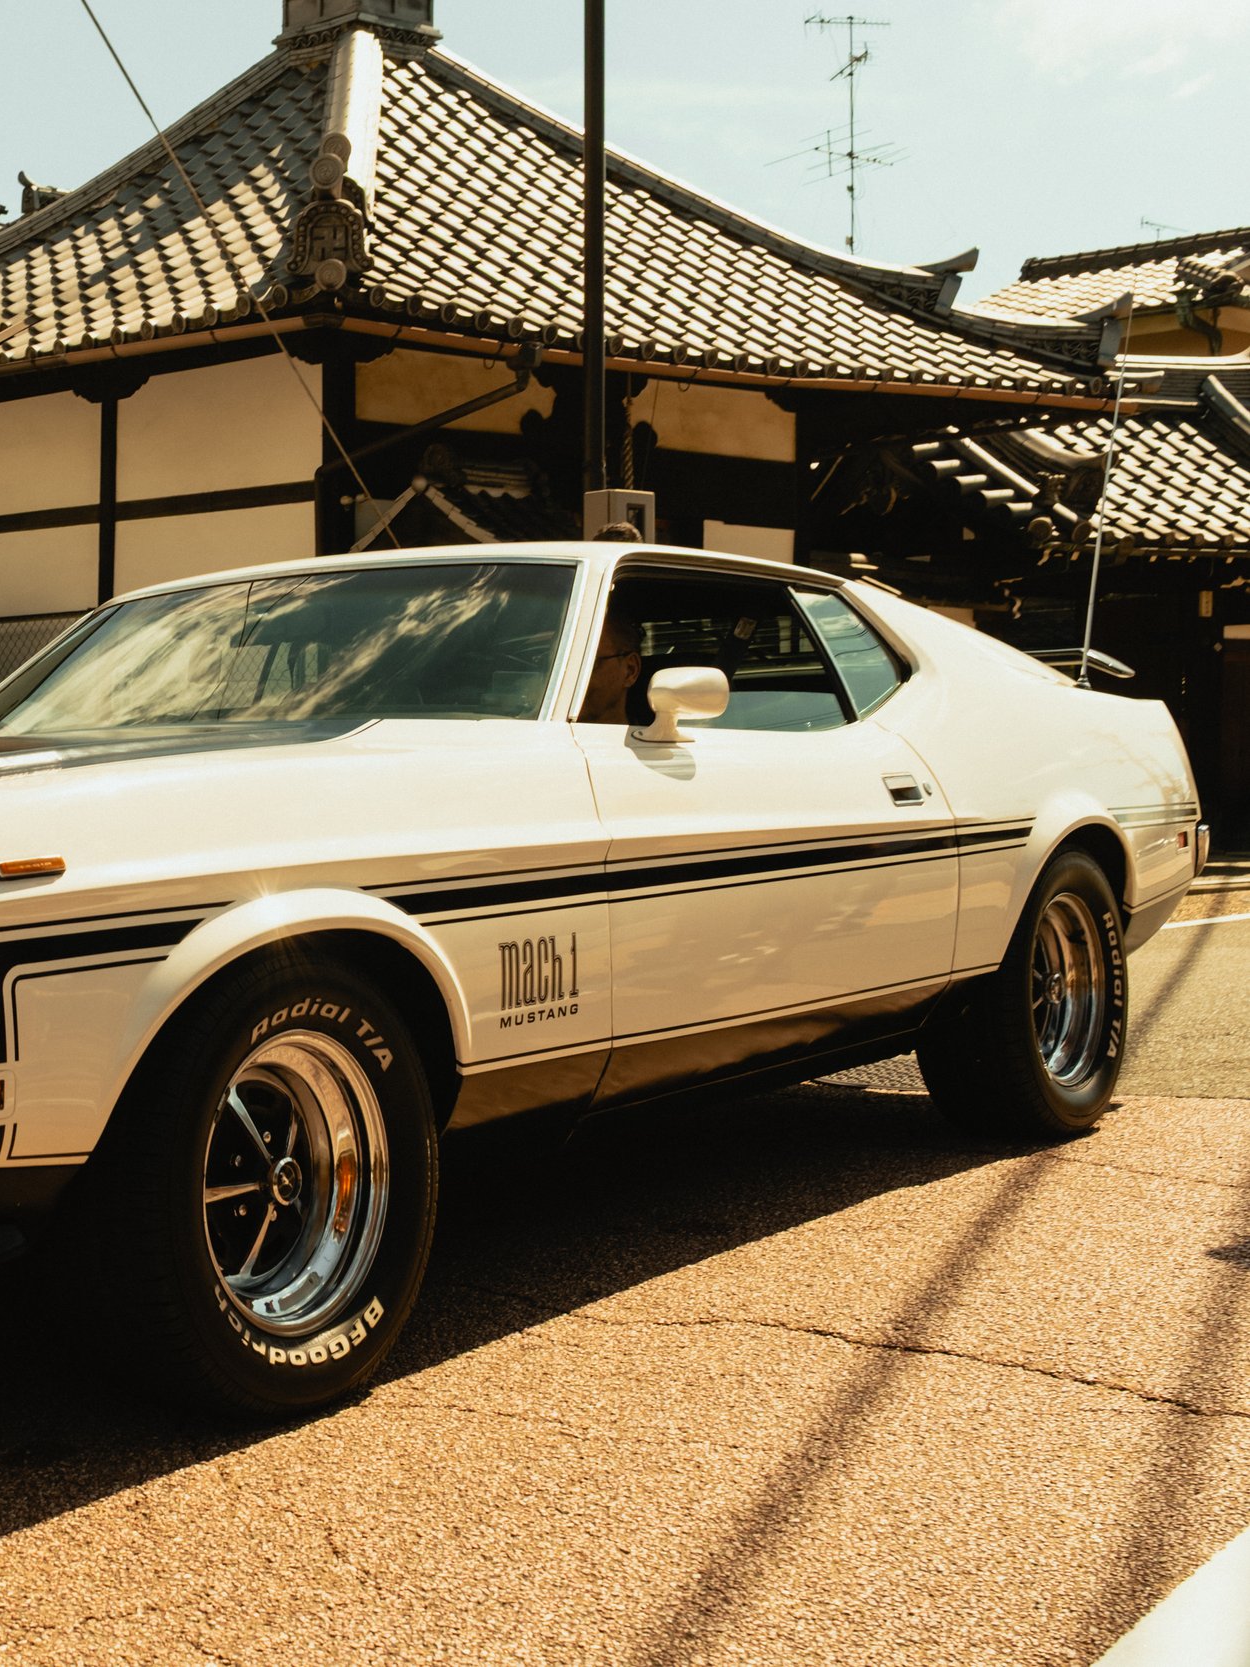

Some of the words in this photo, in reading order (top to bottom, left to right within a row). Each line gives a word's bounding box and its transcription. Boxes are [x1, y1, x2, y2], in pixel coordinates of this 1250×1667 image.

[1102, 911, 1123, 1008] Radial
[250, 998, 351, 1045] Radial
[355, 1018, 393, 1072] T/A
[499, 1003, 579, 1029] MUSTANG
[1106, 1018, 1122, 1058] T/A
[214, 1283, 385, 1366] BFGoodrich
